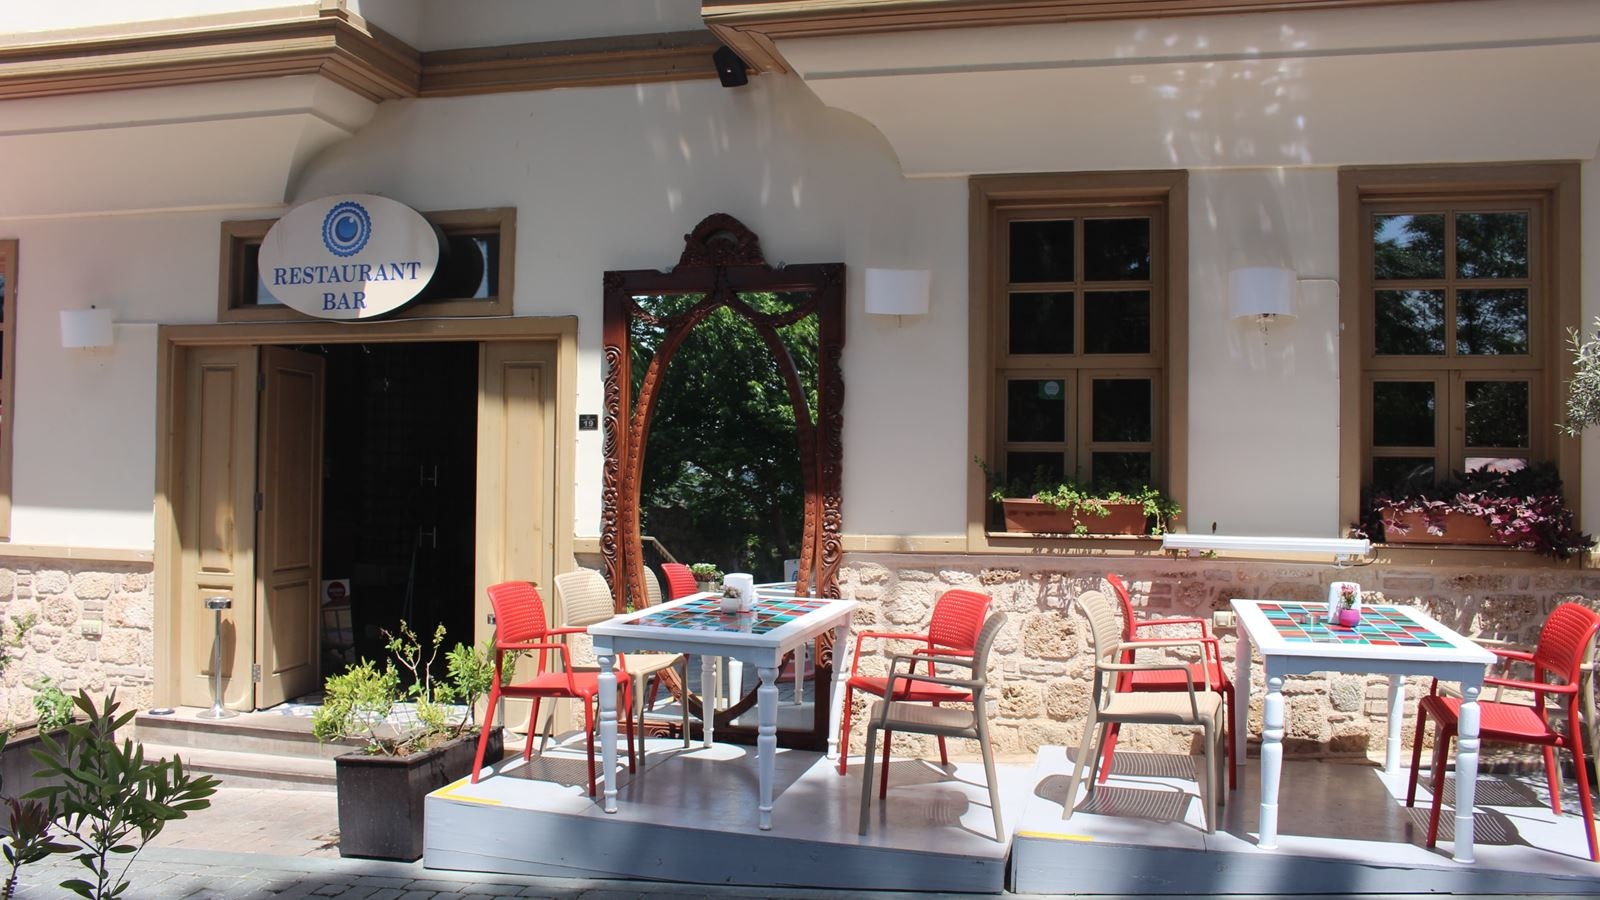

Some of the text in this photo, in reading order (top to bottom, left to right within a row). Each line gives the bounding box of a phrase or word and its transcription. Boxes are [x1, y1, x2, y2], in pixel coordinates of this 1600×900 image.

[273, 262, 421, 285] RESTAURANT
[322, 291, 367, 310] BAR
[583, 419, 594, 427] 19
